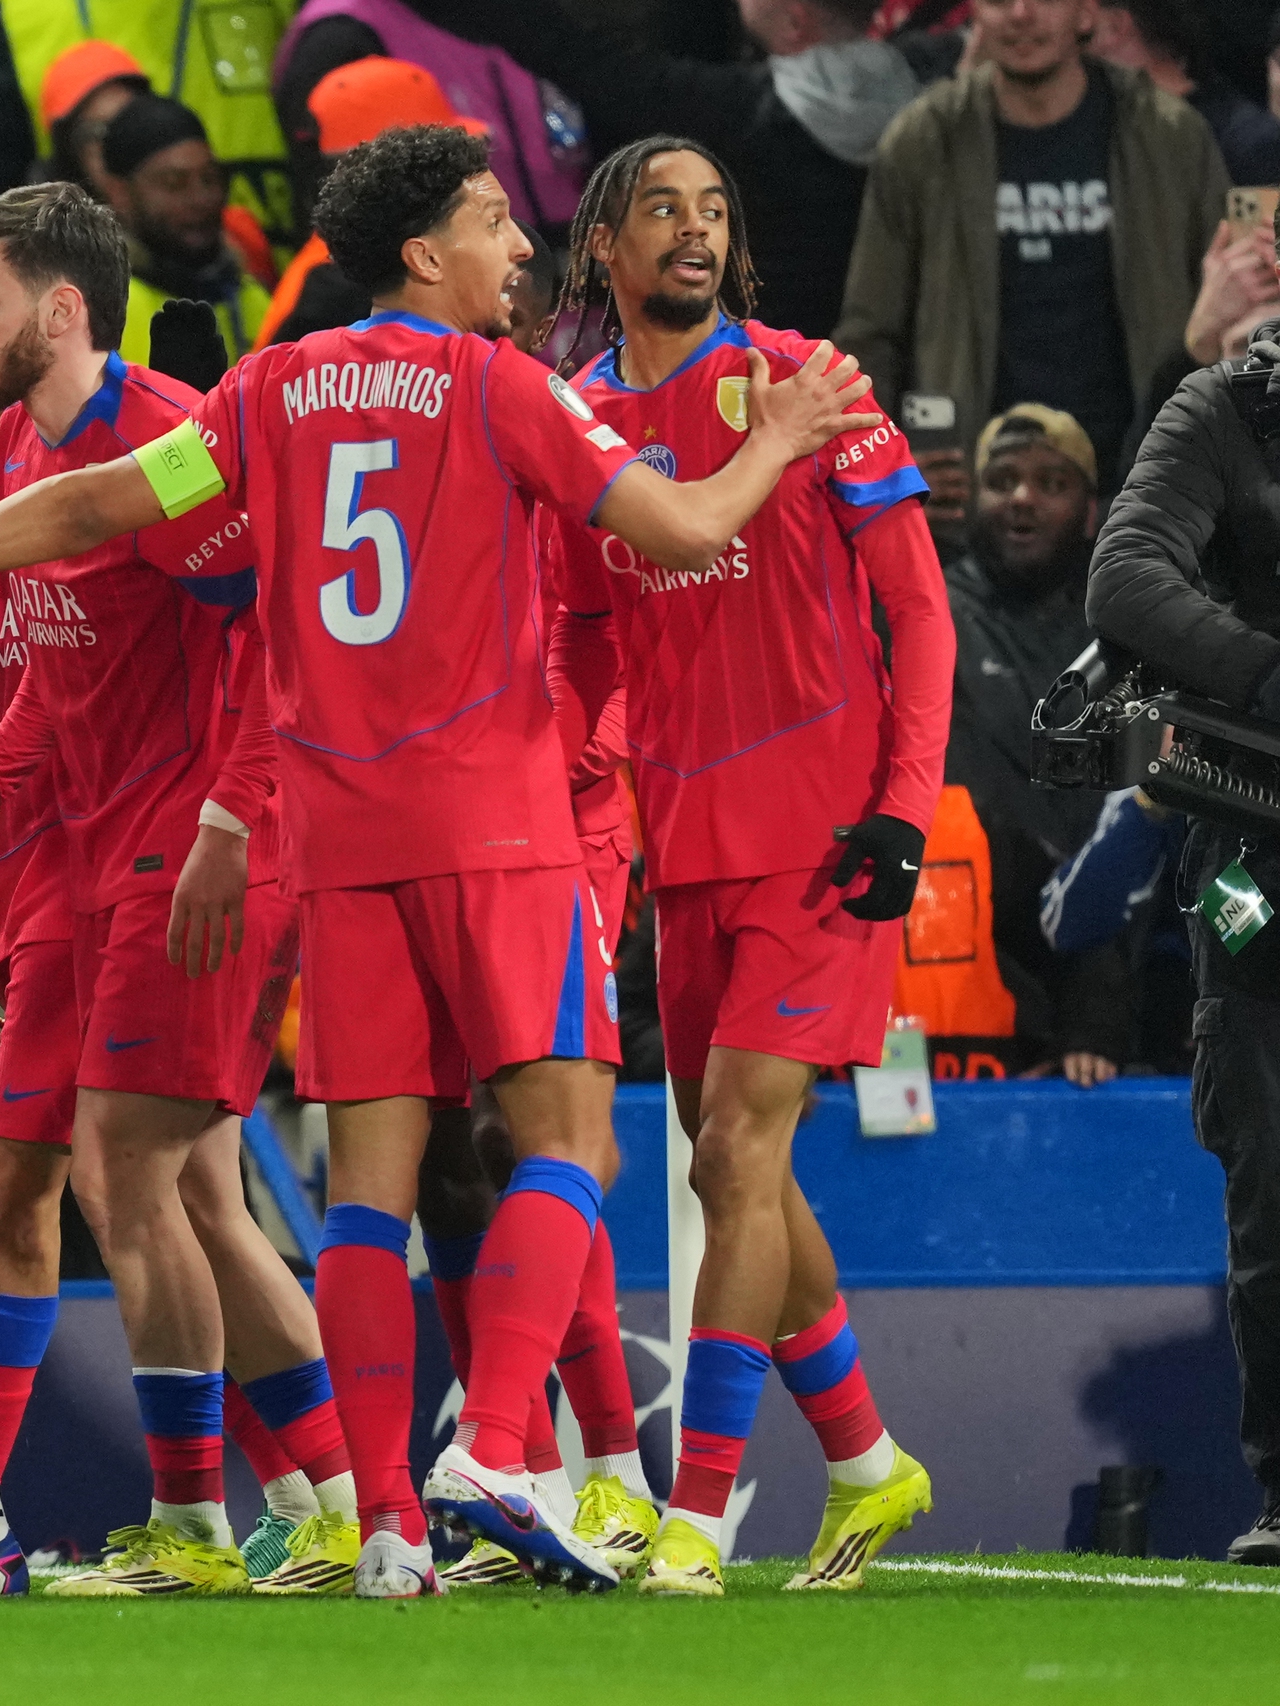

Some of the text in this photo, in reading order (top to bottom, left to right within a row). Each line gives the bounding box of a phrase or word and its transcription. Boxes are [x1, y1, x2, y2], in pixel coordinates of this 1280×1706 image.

[996, 180, 1114, 232] ARIS
[282, 360, 452, 425] MARQUINHOS
[835, 420, 899, 471] BEYO
[185, 512, 250, 572] BEYO
[319, 438, 412, 646] 5
[8, 571, 87, 623] QATAR
[27, 620, 97, 648] AIRWAYS
